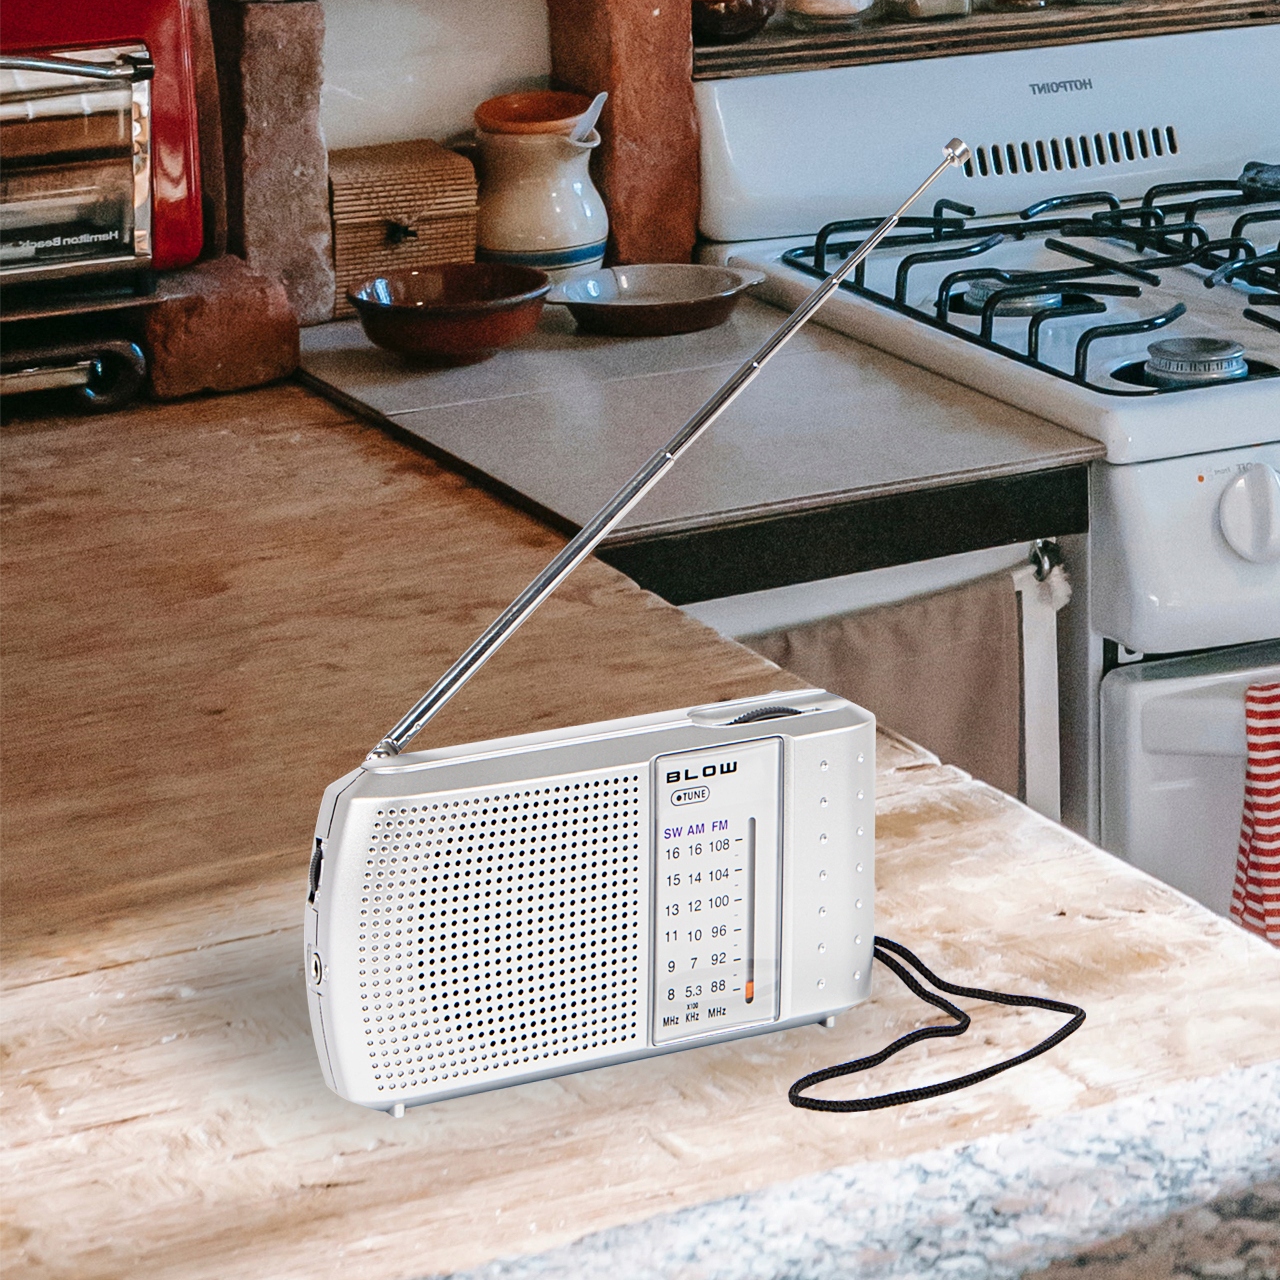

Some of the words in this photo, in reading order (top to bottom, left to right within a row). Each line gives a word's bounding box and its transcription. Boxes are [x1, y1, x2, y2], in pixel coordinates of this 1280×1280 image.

[667, 761, 737, 783] BLOW
[683, 790, 706, 801] TUNE
[664, 827, 682, 839] SW
[687, 823, 705, 836] AM
[712, 820, 728, 832] FM
[666, 847, 680, 860] 16
[689, 843, 702, 856] 16
[709, 839, 730, 852] 108
[667, 874, 681, 886] 15
[689, 872, 702, 884] 14
[709, 868, 729, 881] 104
[665, 904, 680, 916] 13
[688, 900, 702, 912] 12
[709, 895, 729, 908] 100
[665, 930, 678, 942] 11
[688, 930, 702, 942] 10
[712, 924, 727, 938] 96
[668, 960, 675, 972] 9
[691, 957, 698, 969] 7
[711, 952, 726, 965] 92
[667, 989, 675, 1000] 8
[685, 985, 702, 998] 5.3
[711, 980, 725, 992] 88
[663, 1016, 679, 1027] MHz
[686, 1012, 699, 1022] KHz
[708, 1007, 726, 1018] MHz
